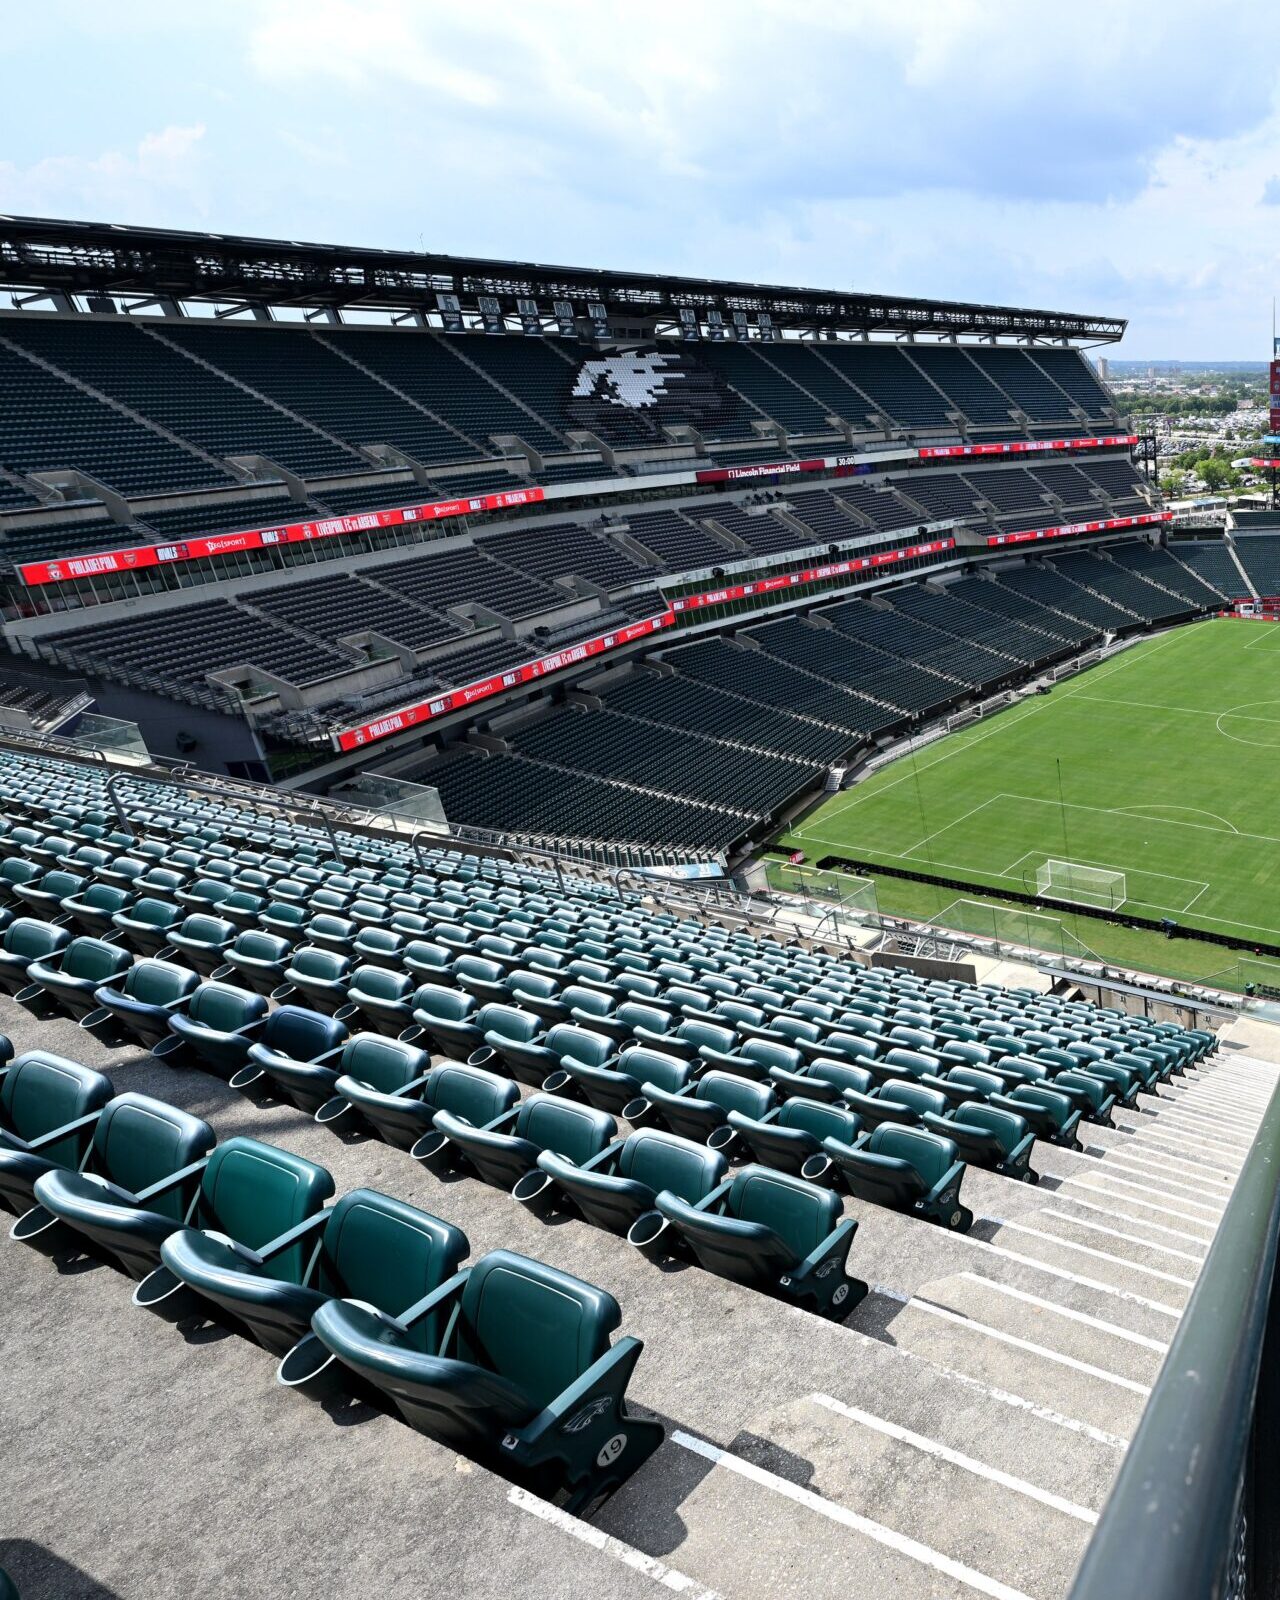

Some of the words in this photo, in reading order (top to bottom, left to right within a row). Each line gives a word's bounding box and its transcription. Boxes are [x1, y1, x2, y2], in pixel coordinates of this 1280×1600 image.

[443, 296, 454, 312] 5
[734, 467, 758, 478] Lincoln
[758, 465, 785, 475] Financial
[785, 464, 800, 472] Field
[838, 457, 855, 466] 30:00
[316, 520, 343, 536] LIVERPOOL
[343, 518, 352, 531] FC
[357, 514, 380, 528] ARSENAL
[68, 555, 119, 576] PHILADELPHIA
[368, 715, 404, 738] PHILADELPHIA
[834, 1286, 847, 1304] 18
[601, 1438, 622, 1462] 19
